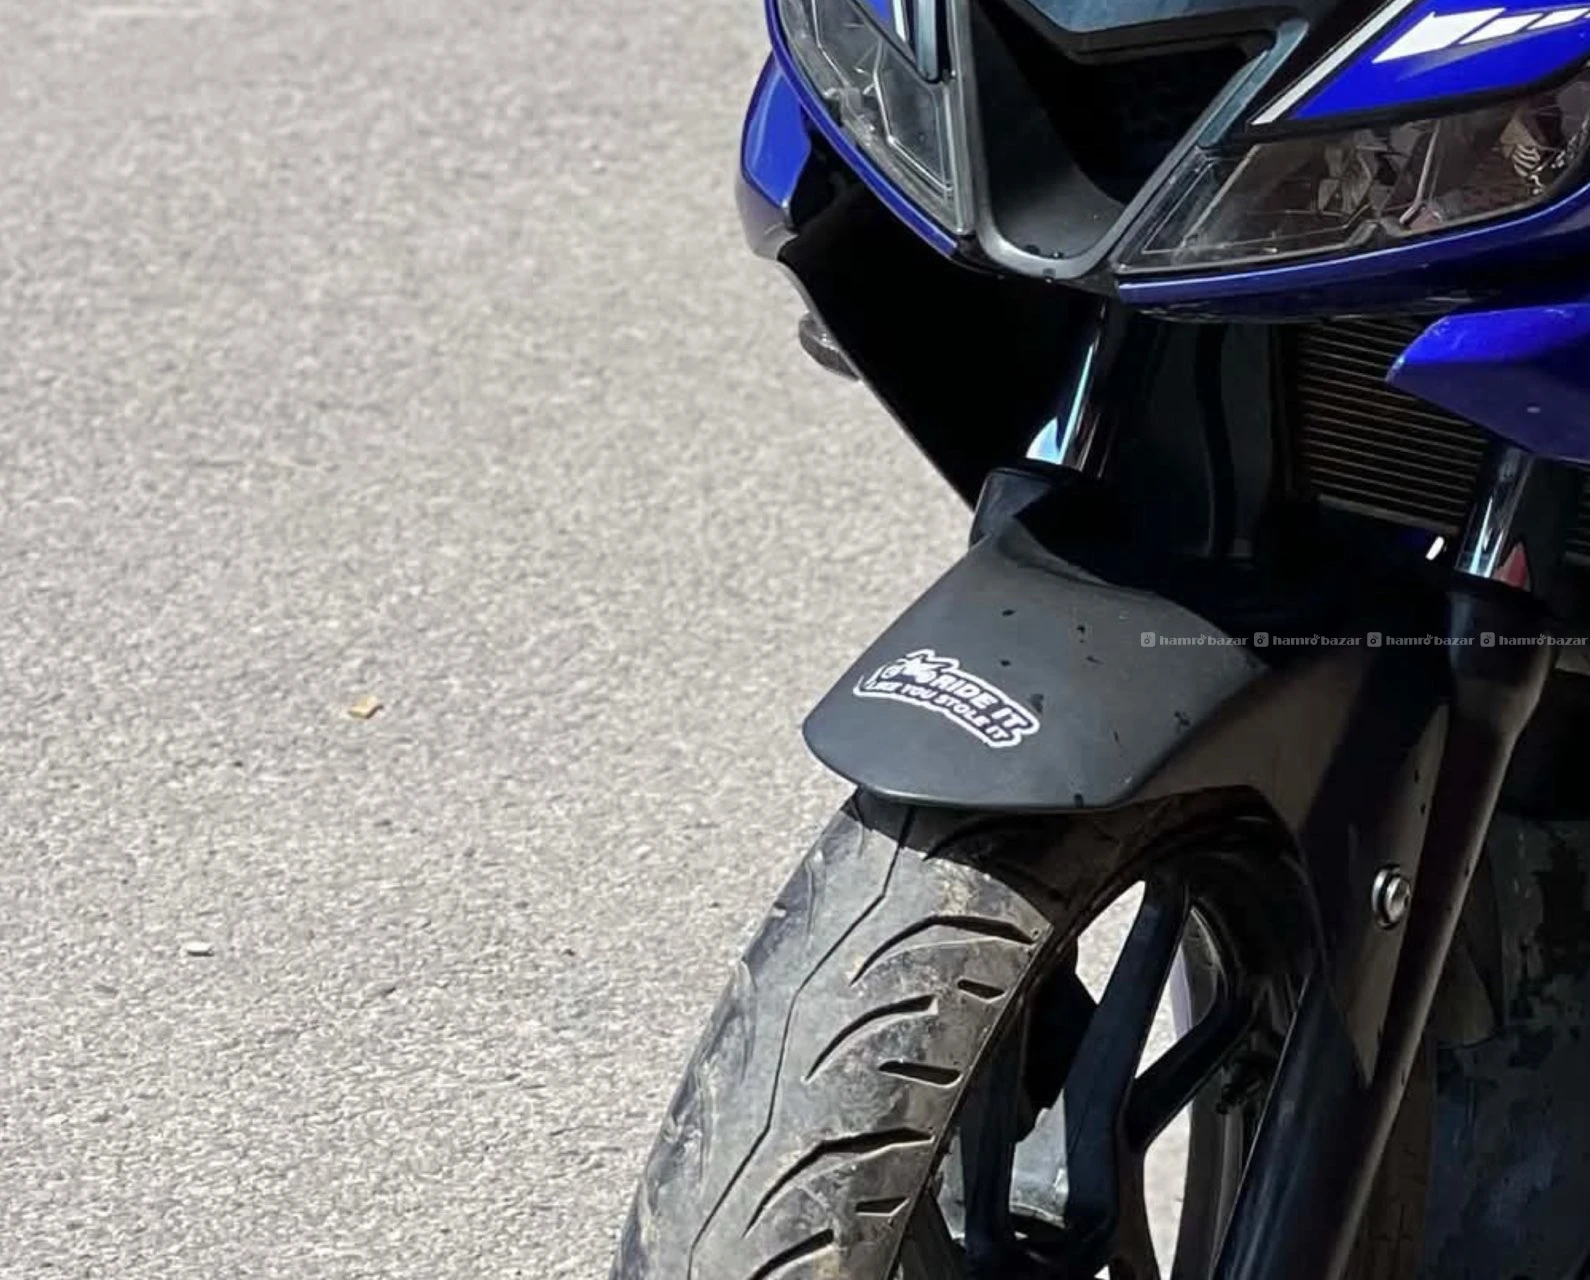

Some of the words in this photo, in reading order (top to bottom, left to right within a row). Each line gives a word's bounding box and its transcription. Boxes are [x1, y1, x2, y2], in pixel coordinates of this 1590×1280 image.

[900, 683, 939, 700] YOU
[932, 693, 988, 731] STOLE
[985, 723, 1009, 740] IT
[928, 671, 997, 709] RIDE
[991, 703, 1028, 728] IT
